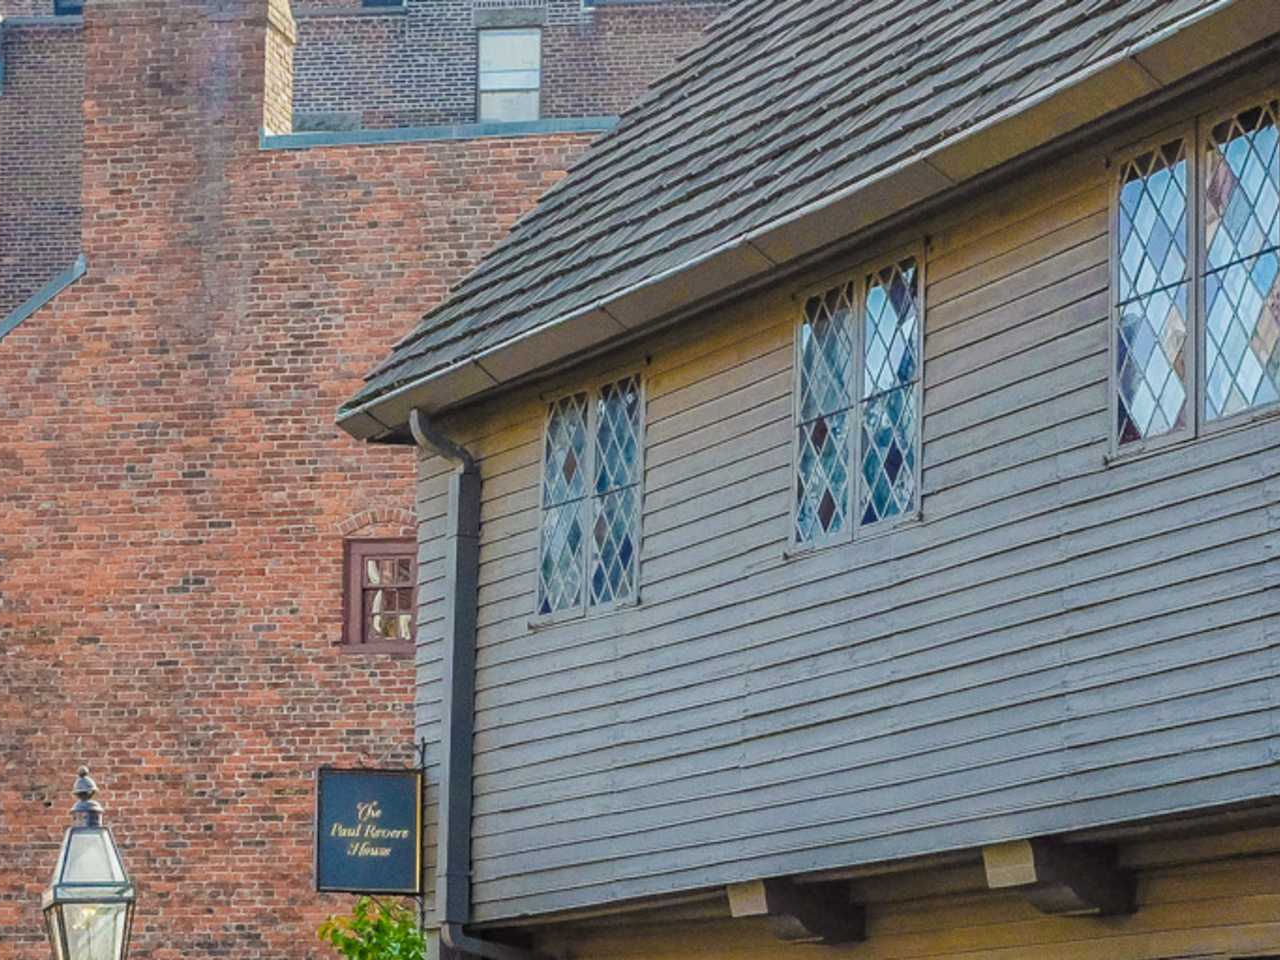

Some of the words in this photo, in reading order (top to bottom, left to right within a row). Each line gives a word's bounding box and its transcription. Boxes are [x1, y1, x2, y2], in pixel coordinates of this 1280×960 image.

[356, 801, 382, 821] The
[330, 823, 362, 837] Paul
[364, 824, 410, 839] Revere
[347, 842, 391, 856] House
